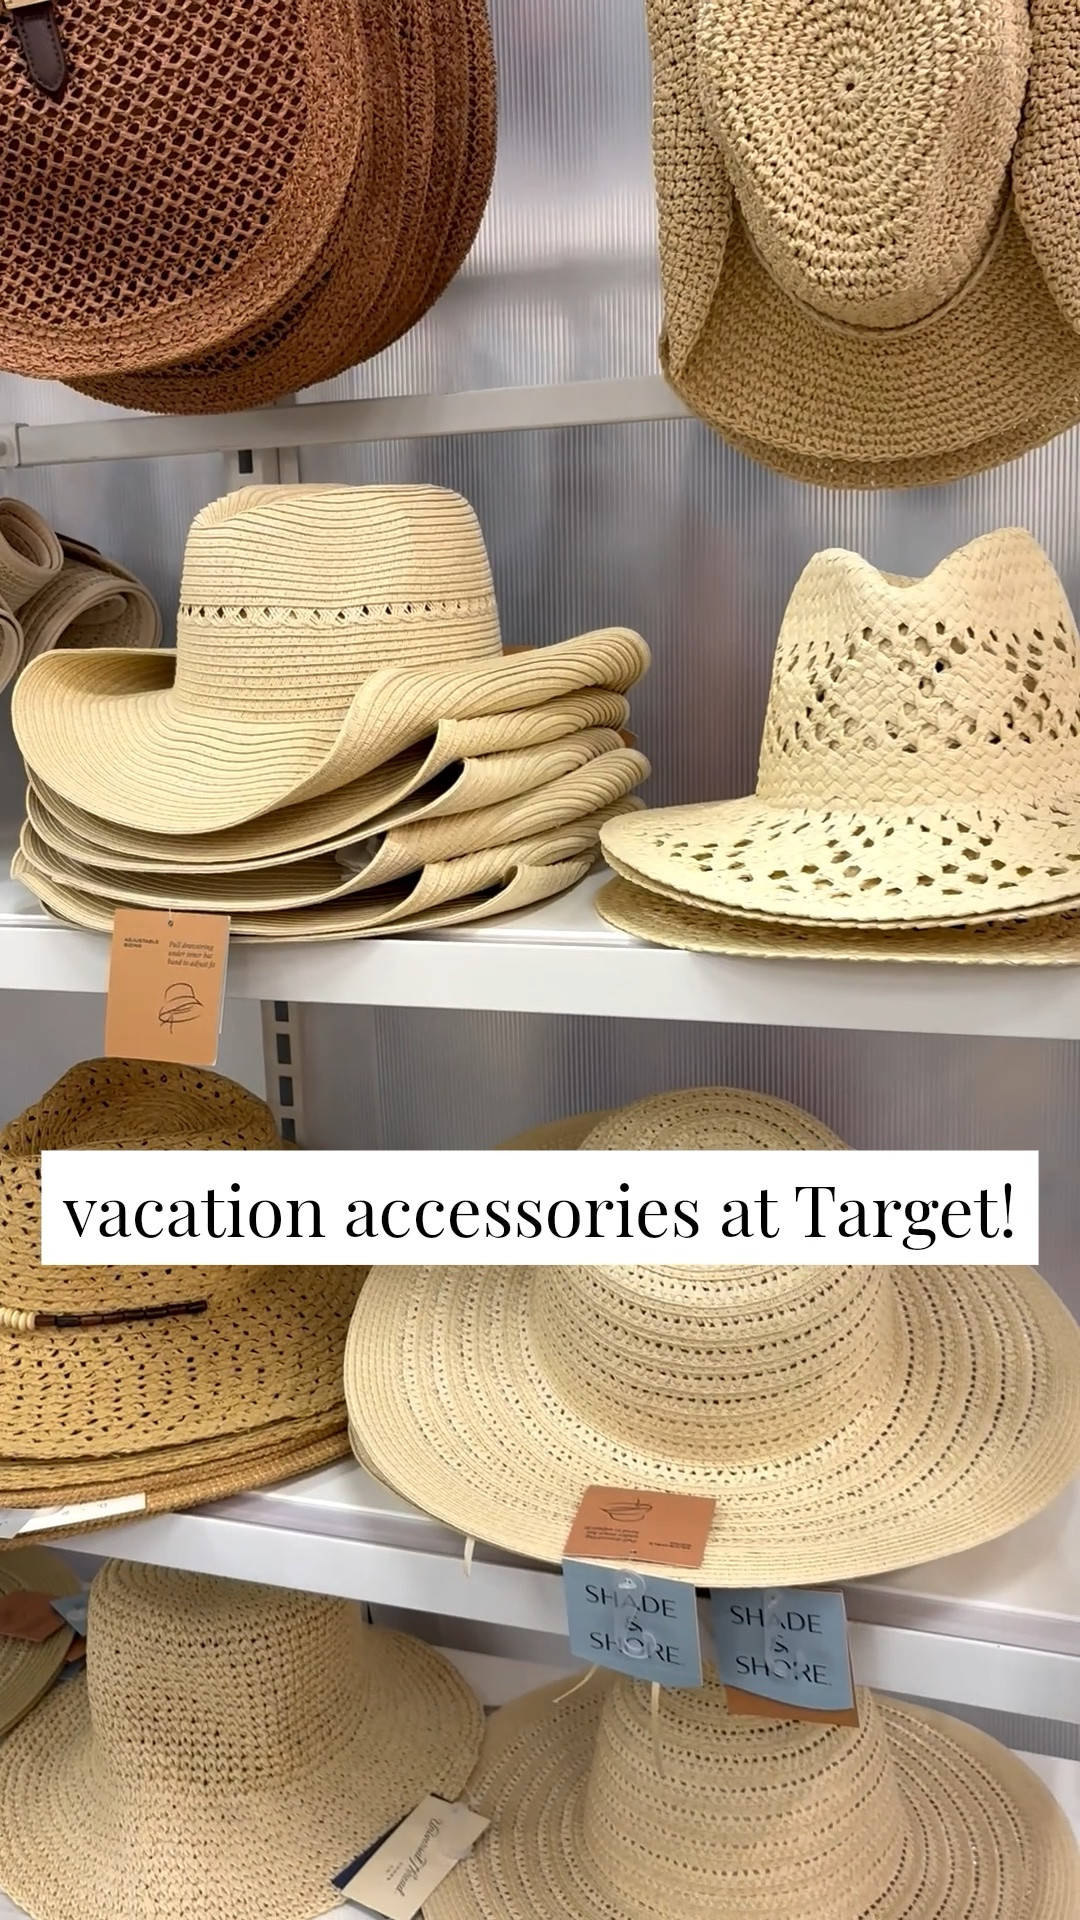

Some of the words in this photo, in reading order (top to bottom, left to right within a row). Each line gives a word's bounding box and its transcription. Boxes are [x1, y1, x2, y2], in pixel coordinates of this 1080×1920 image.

[585, 1584, 678, 1619] SHADE
[730, 1605, 823, 1635] SHADE
[590, 1632, 681, 1666] SHORE
[735, 1655, 828, 1686] SHORE
